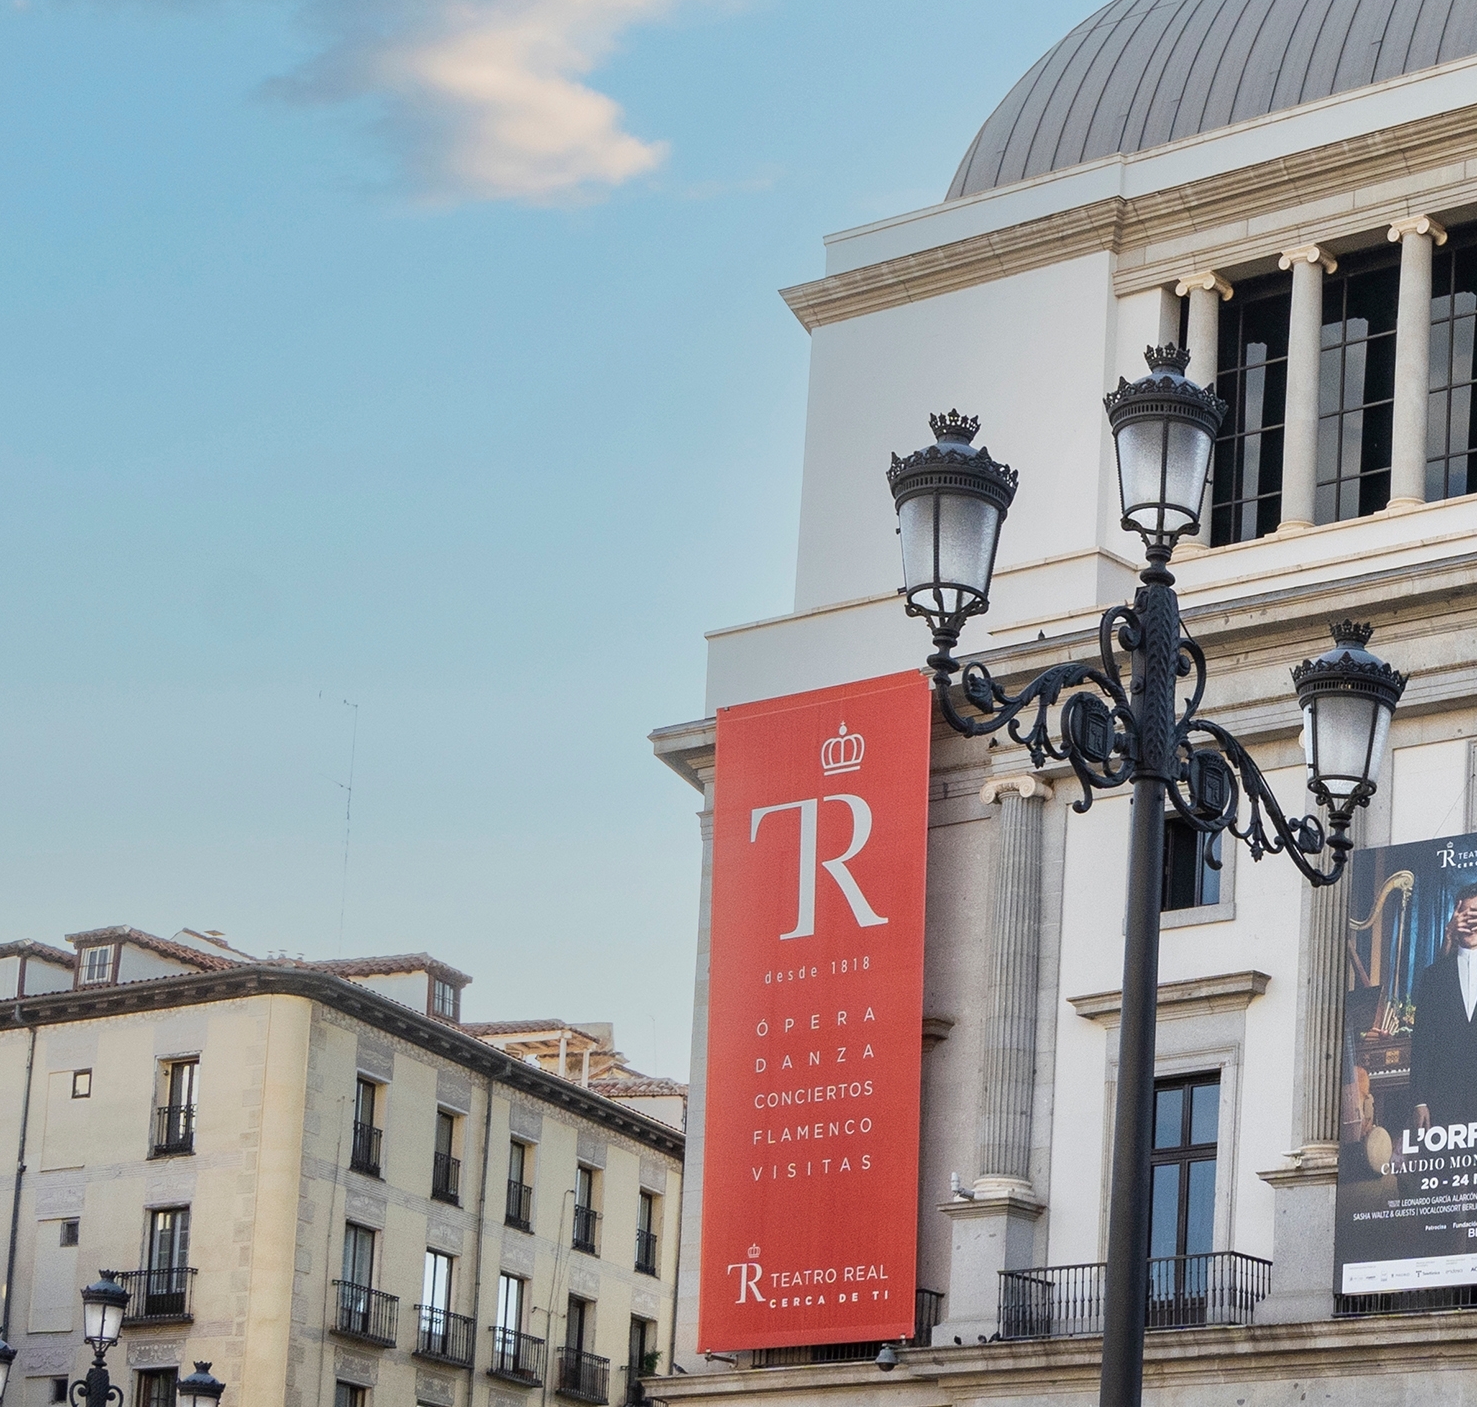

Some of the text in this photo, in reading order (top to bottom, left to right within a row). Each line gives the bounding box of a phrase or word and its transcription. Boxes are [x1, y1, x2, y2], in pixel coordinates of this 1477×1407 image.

[750, 793, 888, 940] TR
[765, 956, 870, 984] desde 1818
[756, 1007, 875, 1036] ÓPERA
[755, 1045, 874, 1073] DANZA
[755, 1081, 873, 1109] CONCIERTOS
[753, 1118, 872, 1145] FLAMENCO
[752, 1155, 871, 1181] VISITAS
[1381, 1158, 1444, 1175] CLAUDIO
[1421, 1177, 1438, 1189] 20
[1452, 1174, 1469, 1186] 24
[1401, 1197, 1430, 1207] LEONARDO
[1431, 1195, 1451, 1204] GARCÍA
[1452, 1192, 1477, 1202] ALARCÓN
[727, 1263, 766, 1304] TR
[771, 1264, 888, 1289] TEATRO REAL
[770, 1290, 888, 1309] CERCA DE TI
